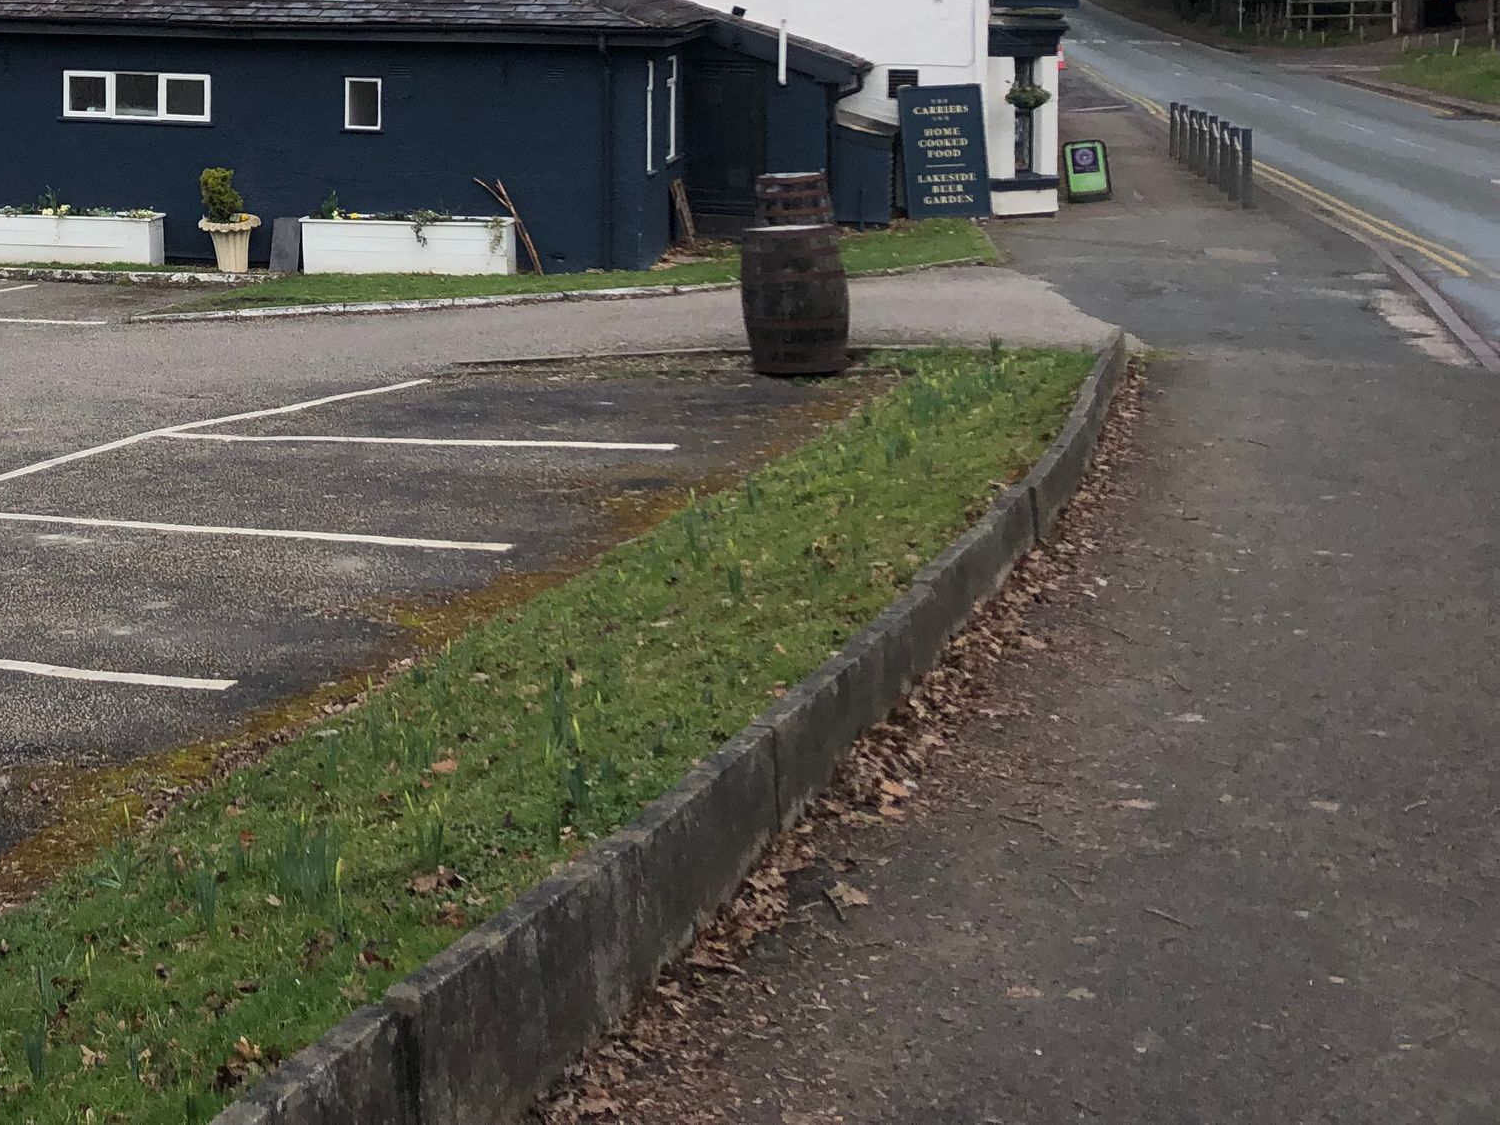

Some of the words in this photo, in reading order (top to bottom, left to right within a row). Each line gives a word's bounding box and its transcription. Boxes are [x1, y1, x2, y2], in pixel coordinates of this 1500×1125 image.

[912, 104, 969, 115] CARRIERS
[923, 127, 961, 136] HOME
[917, 138, 969, 147] COOKED
[927, 149, 961, 158] FOOD
[917, 173, 977, 183] LAKESIDE
[932, 184, 964, 193] BEER
[923, 195, 974, 205] GARDEN
